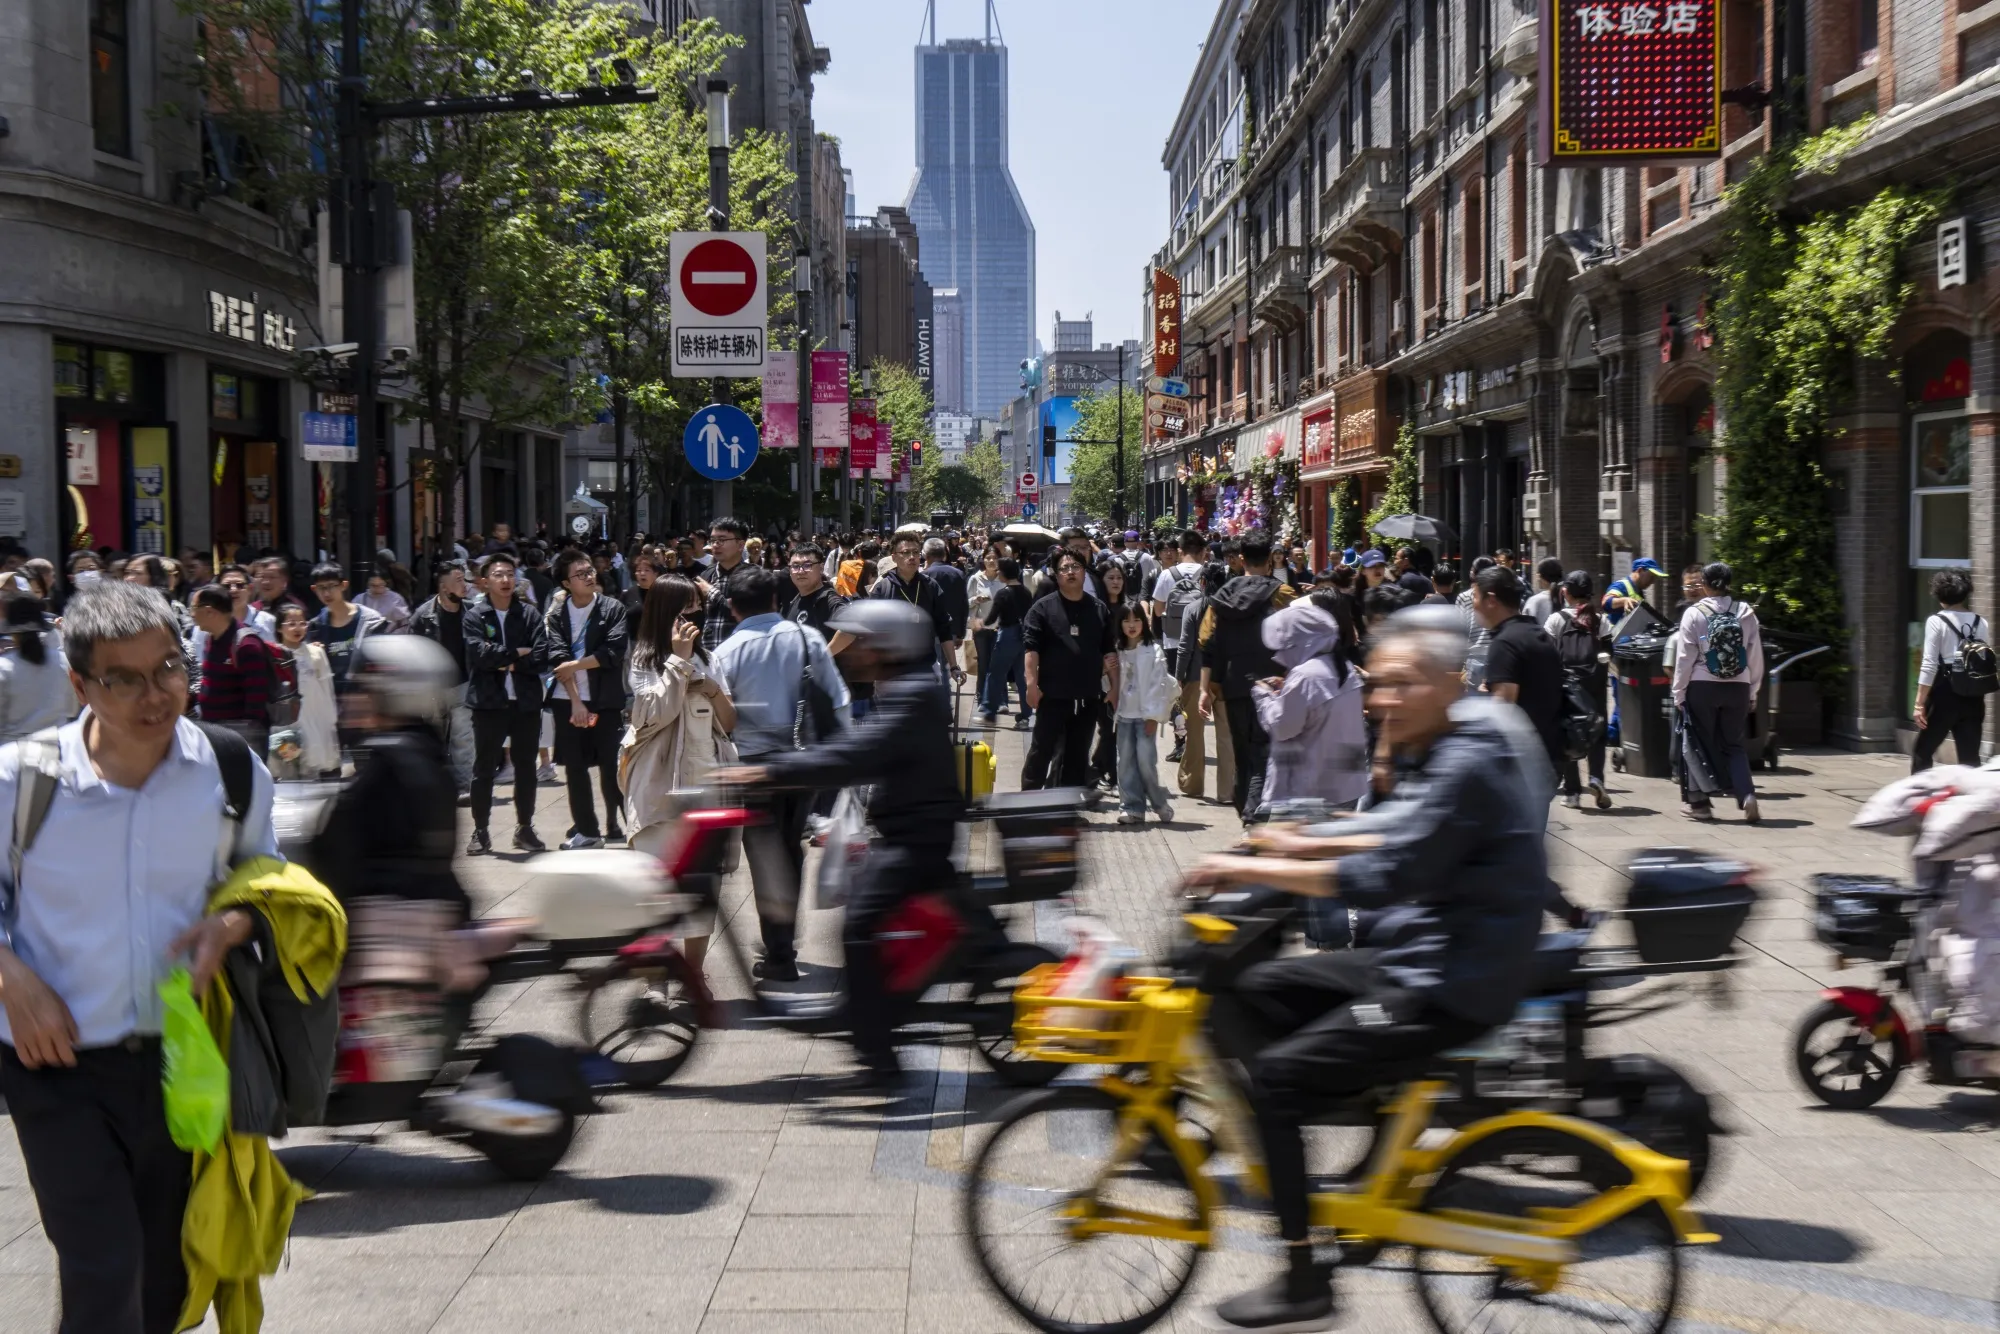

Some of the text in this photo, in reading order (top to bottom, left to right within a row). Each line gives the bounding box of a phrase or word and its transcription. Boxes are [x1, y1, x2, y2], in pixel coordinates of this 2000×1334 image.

[1575, 0, 1703, 37] 体验店
[209, 290, 256, 342] PEZ
[263, 310, 297, 351] 皮礼士
[1157, 292, 1177, 356] 稻香村
[680, 334, 759, 359] 除特种车辆外
[918, 318, 930, 381] HUAWEI
